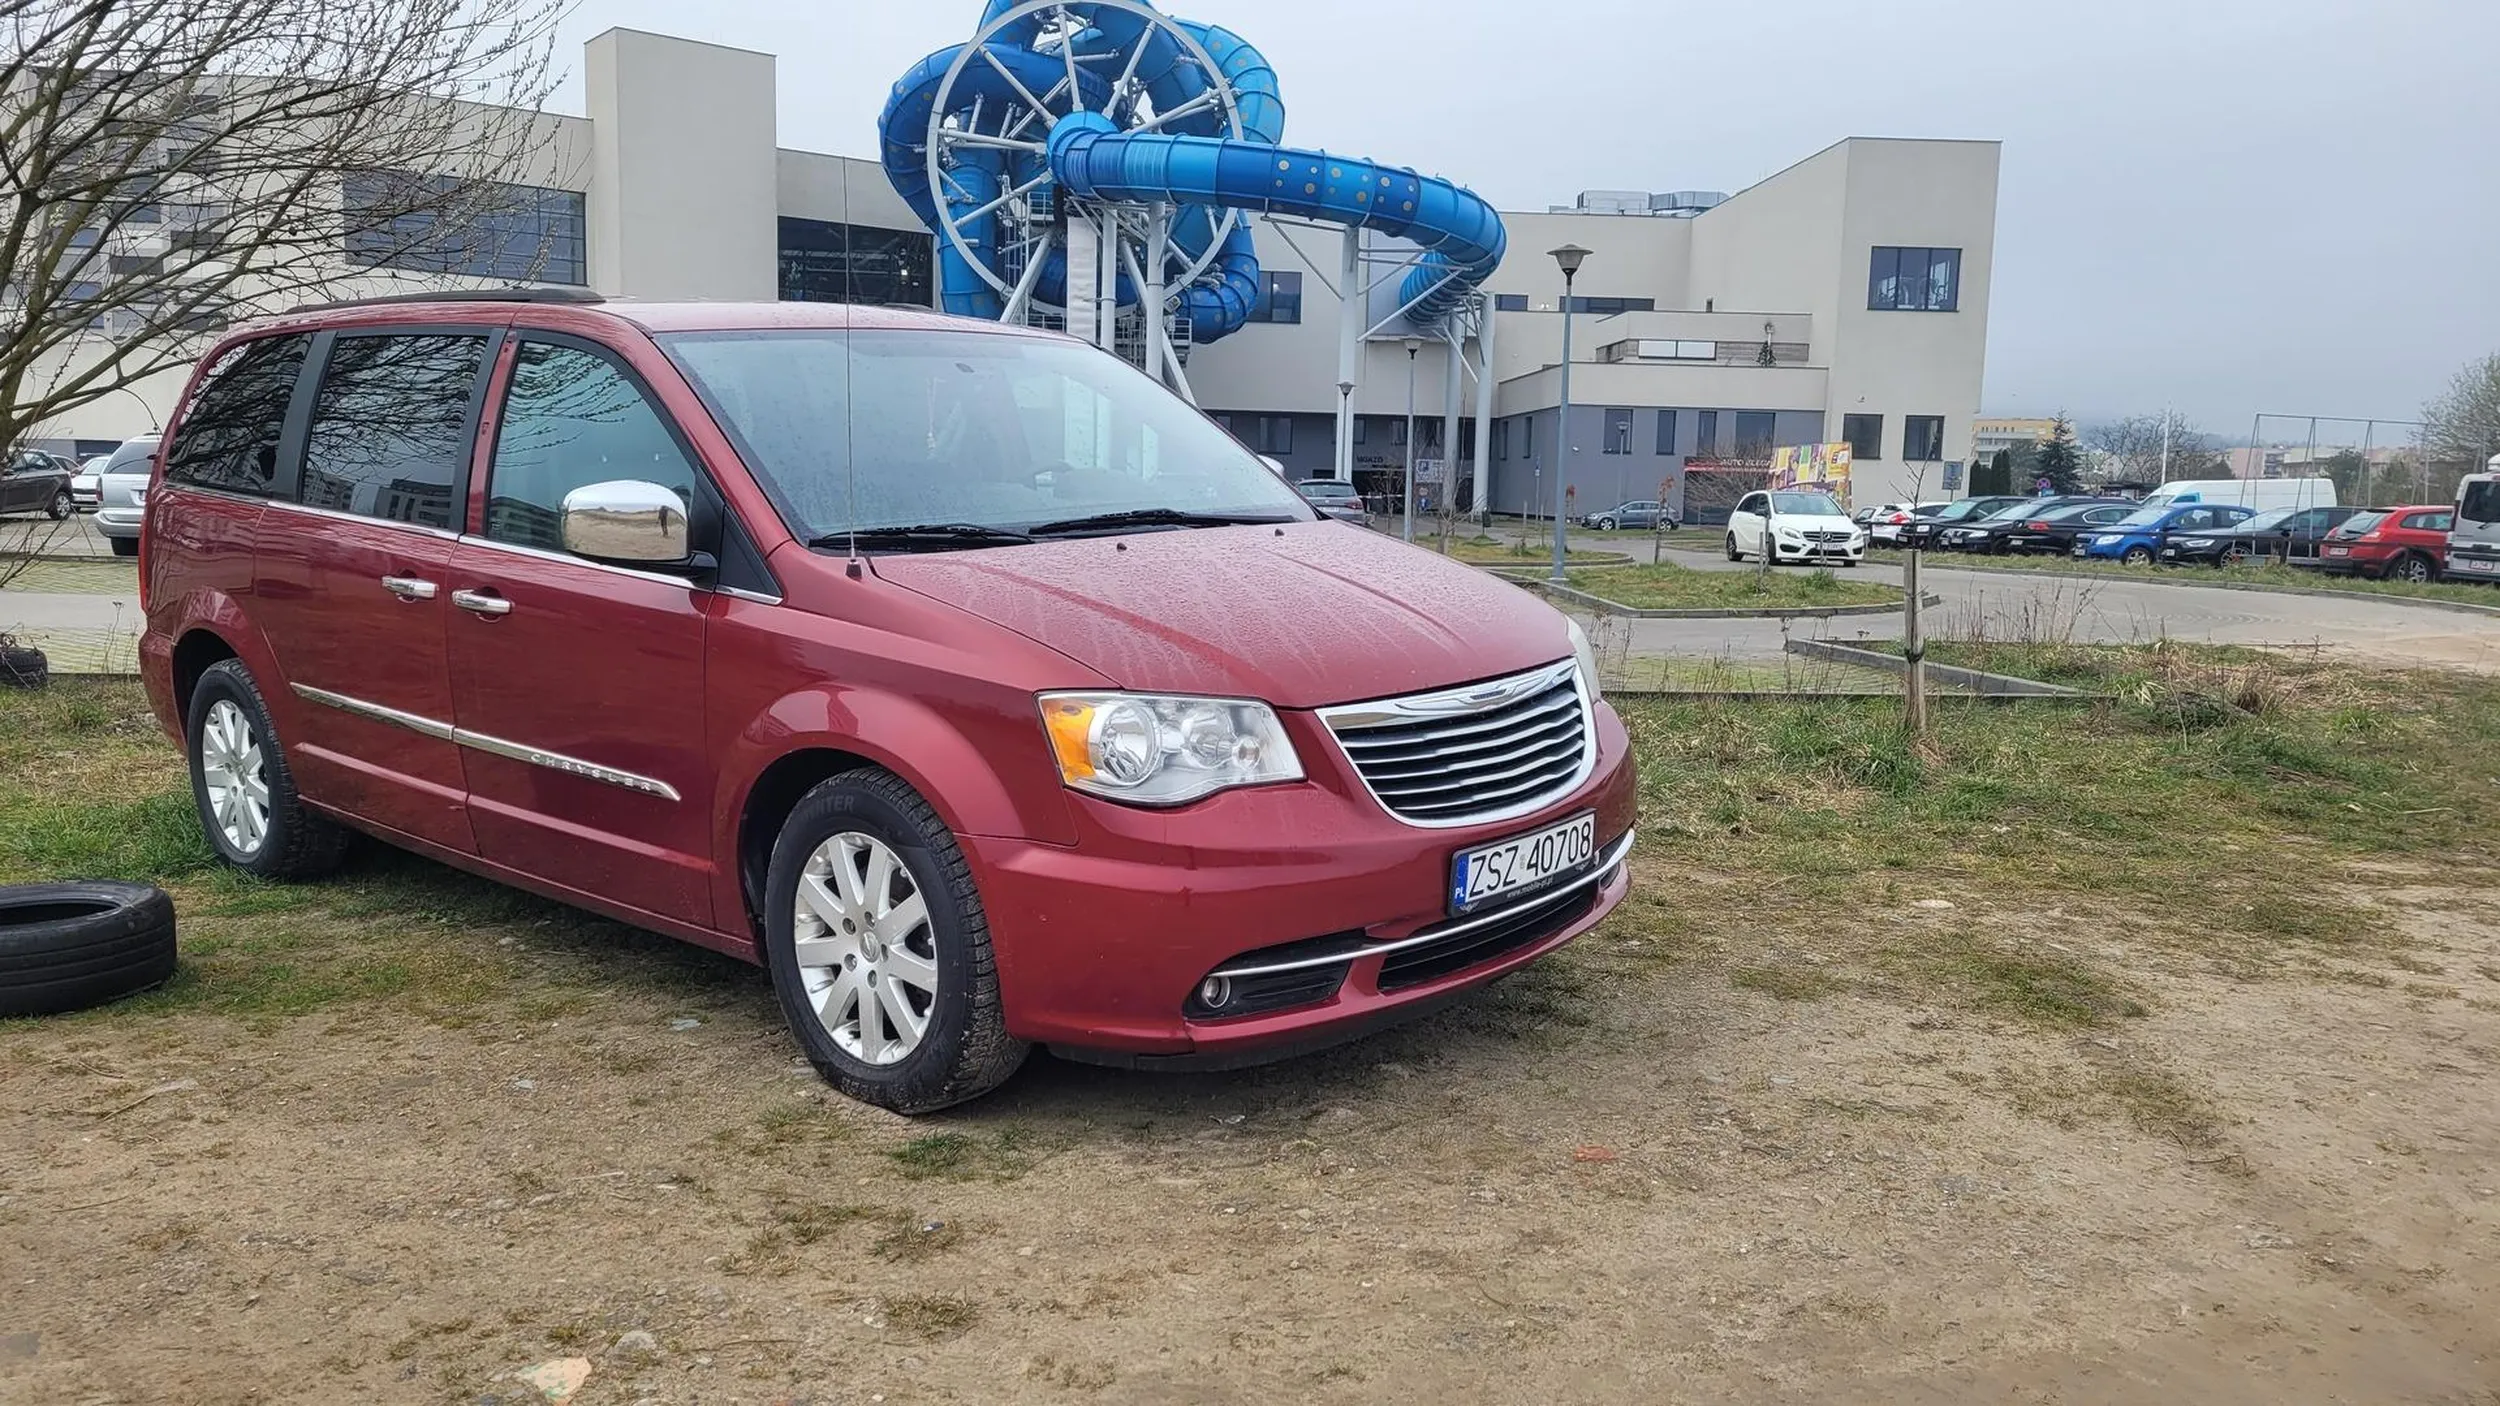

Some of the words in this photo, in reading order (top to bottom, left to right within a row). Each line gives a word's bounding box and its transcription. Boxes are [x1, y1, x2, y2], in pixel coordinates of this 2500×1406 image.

[530, 753, 652, 791] CHRYSLER
[1469, 845, 1519, 897] ZSZ
[1526, 821, 1591, 877] 40708
[1455, 886, 1464, 899] PL
